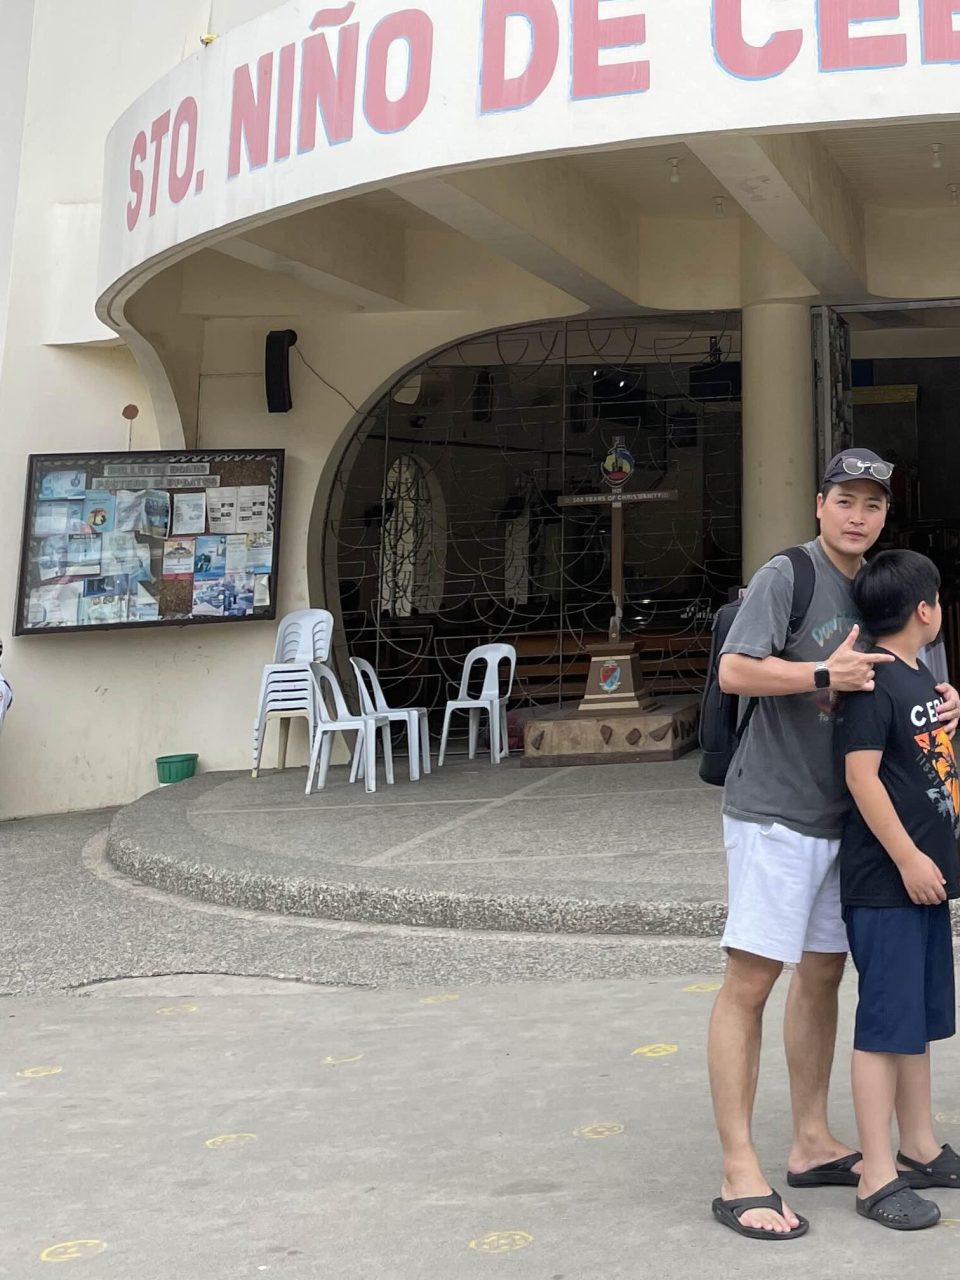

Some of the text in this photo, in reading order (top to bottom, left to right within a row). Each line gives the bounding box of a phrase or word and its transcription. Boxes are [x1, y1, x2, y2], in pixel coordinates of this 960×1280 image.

[125, 97, 206, 231] STO.
[227, 1, 434, 180] NIÑO
[910, 696, 945, 727] CE
